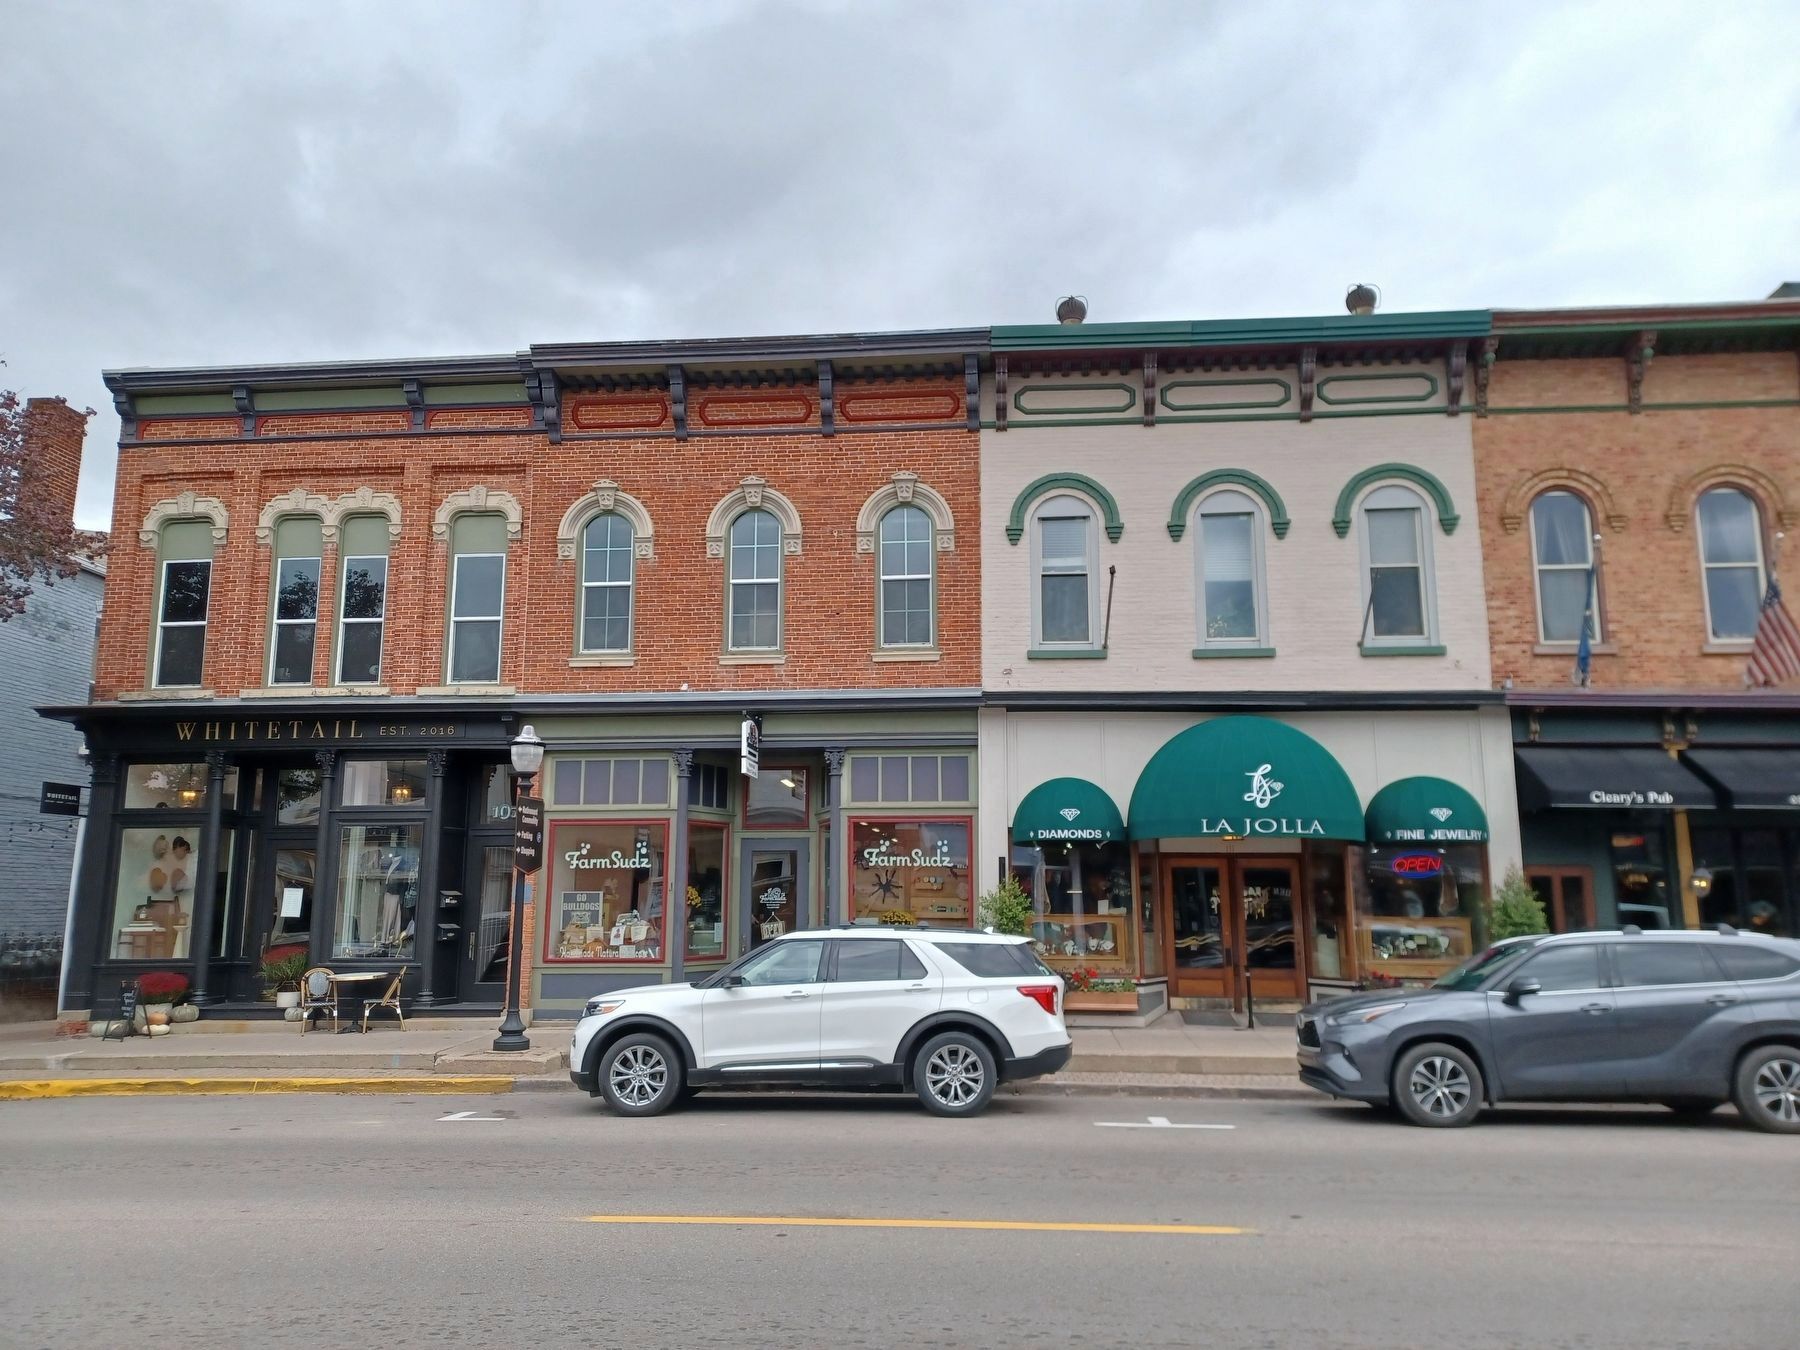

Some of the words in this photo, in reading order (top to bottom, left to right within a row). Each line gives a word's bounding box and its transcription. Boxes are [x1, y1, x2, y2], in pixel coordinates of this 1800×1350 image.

[176, 720, 363, 741] WHITETAIL
[379, 726, 412, 736] EST.
[420, 725, 456, 736] 2016
[1590, 791, 1644, 805] Cleary's
[1647, 791, 1674, 804] Pub
[1038, 829, 1102, 839] DIAMONDS
[1201, 818, 1235, 834] LA
[1243, 818, 1326, 837] JOLLA
[1395, 829, 1425, 840] FINE
[1430, 829, 1482, 841] JEWELRY
[1393, 856, 1442, 873] OPEN
[576, 893, 588, 902] GO
[562, 902, 601, 911] BULLDOGS
